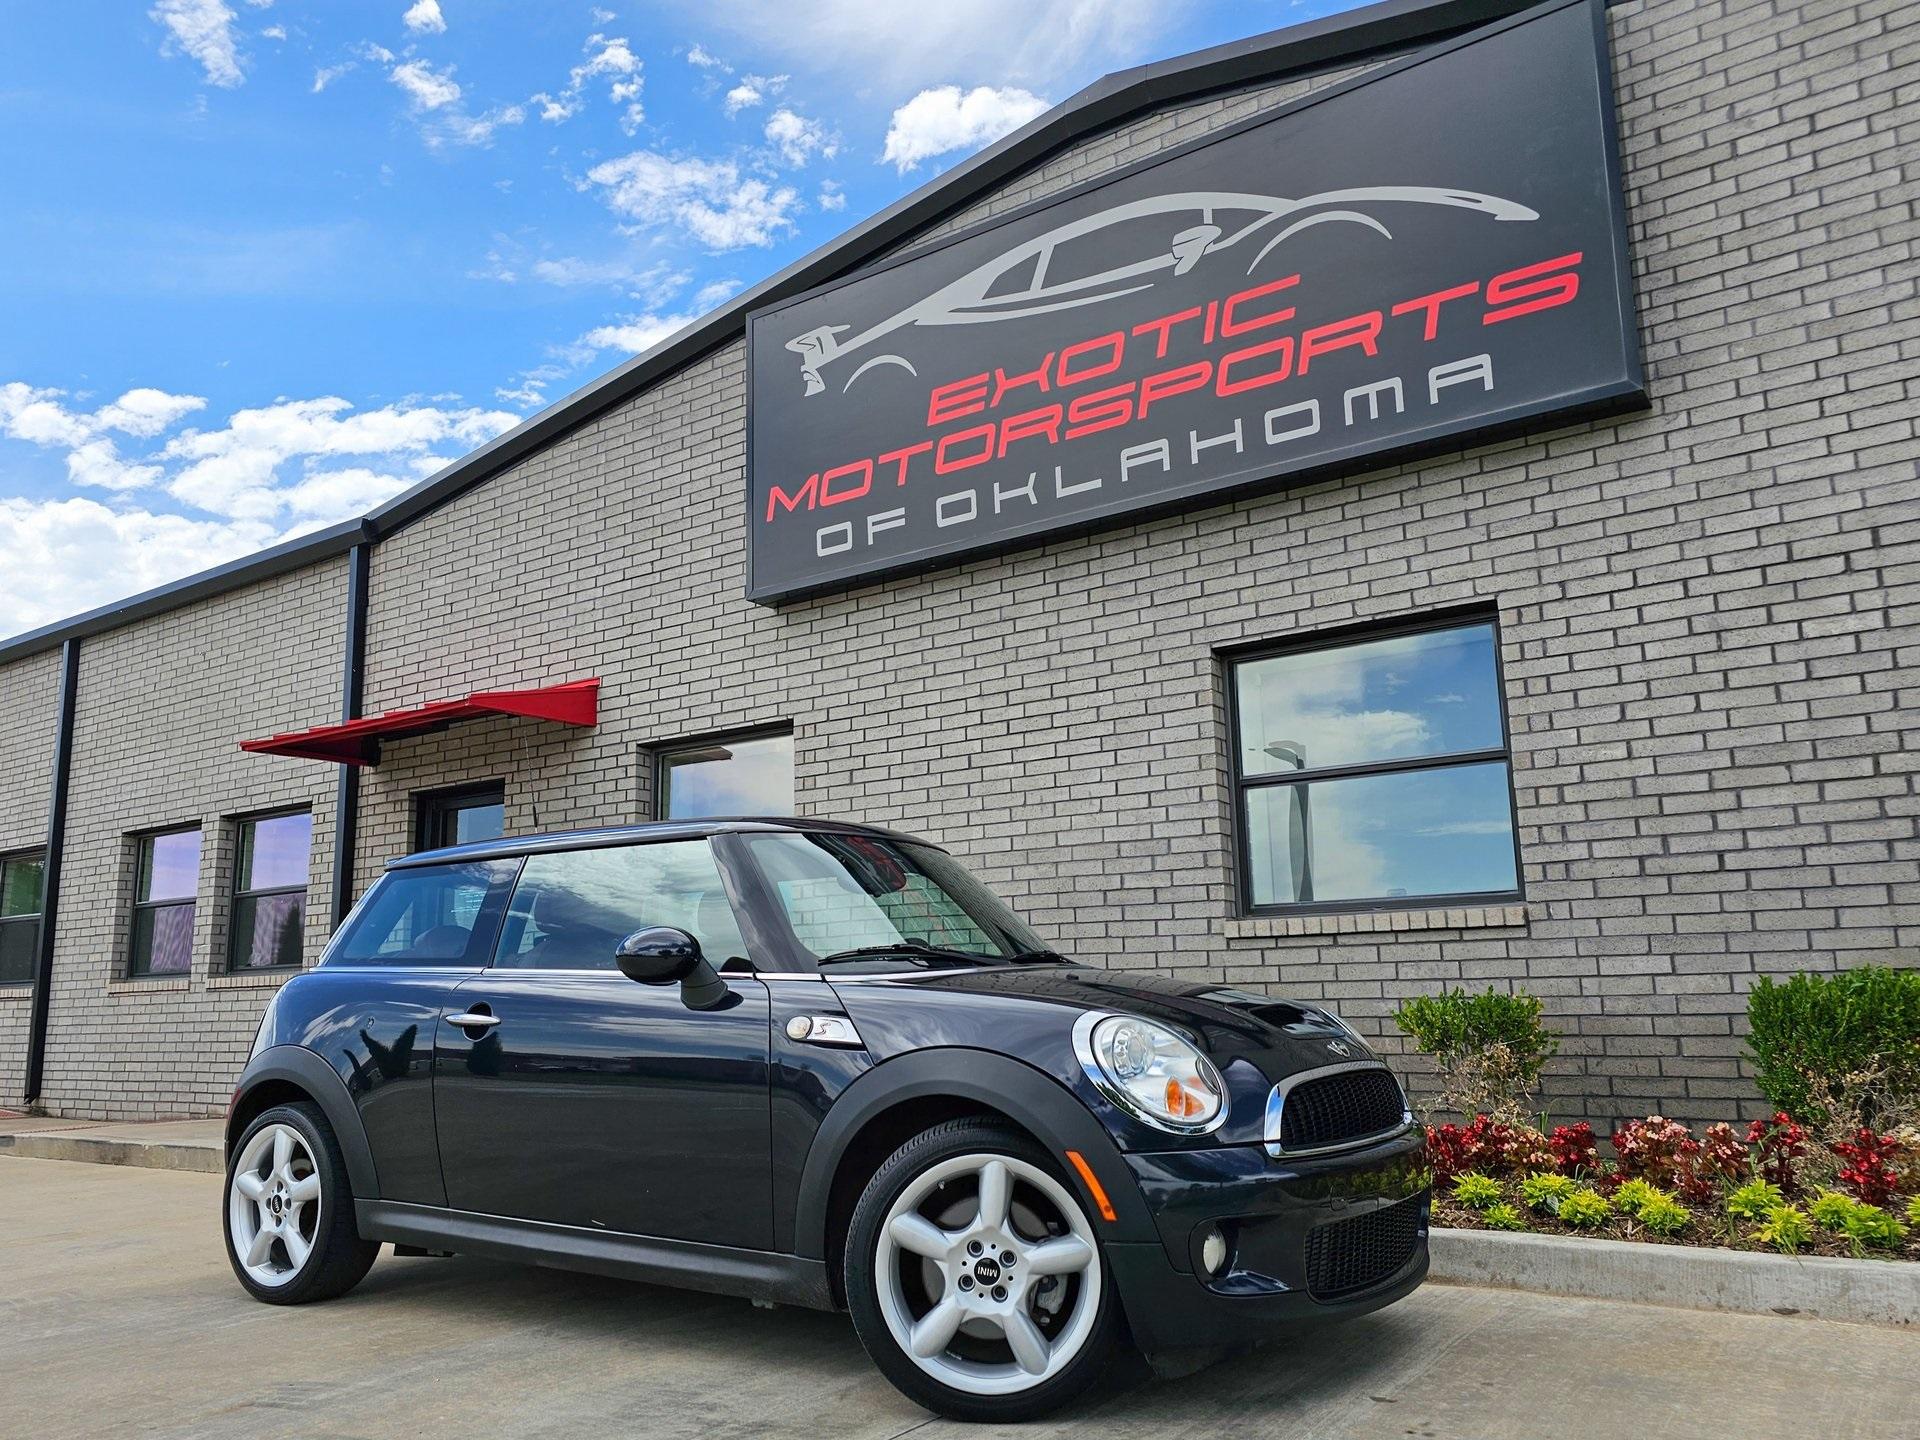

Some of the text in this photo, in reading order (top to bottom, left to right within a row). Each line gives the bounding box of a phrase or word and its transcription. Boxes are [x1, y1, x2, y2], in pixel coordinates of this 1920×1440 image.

[766, 252, 1584, 522] MOTORSPORTS
[927, 275, 1301, 426] EXOTIC
[815, 353, 1495, 558] OF OKLAHOMA
[976, 1265, 999, 1279] MINI
